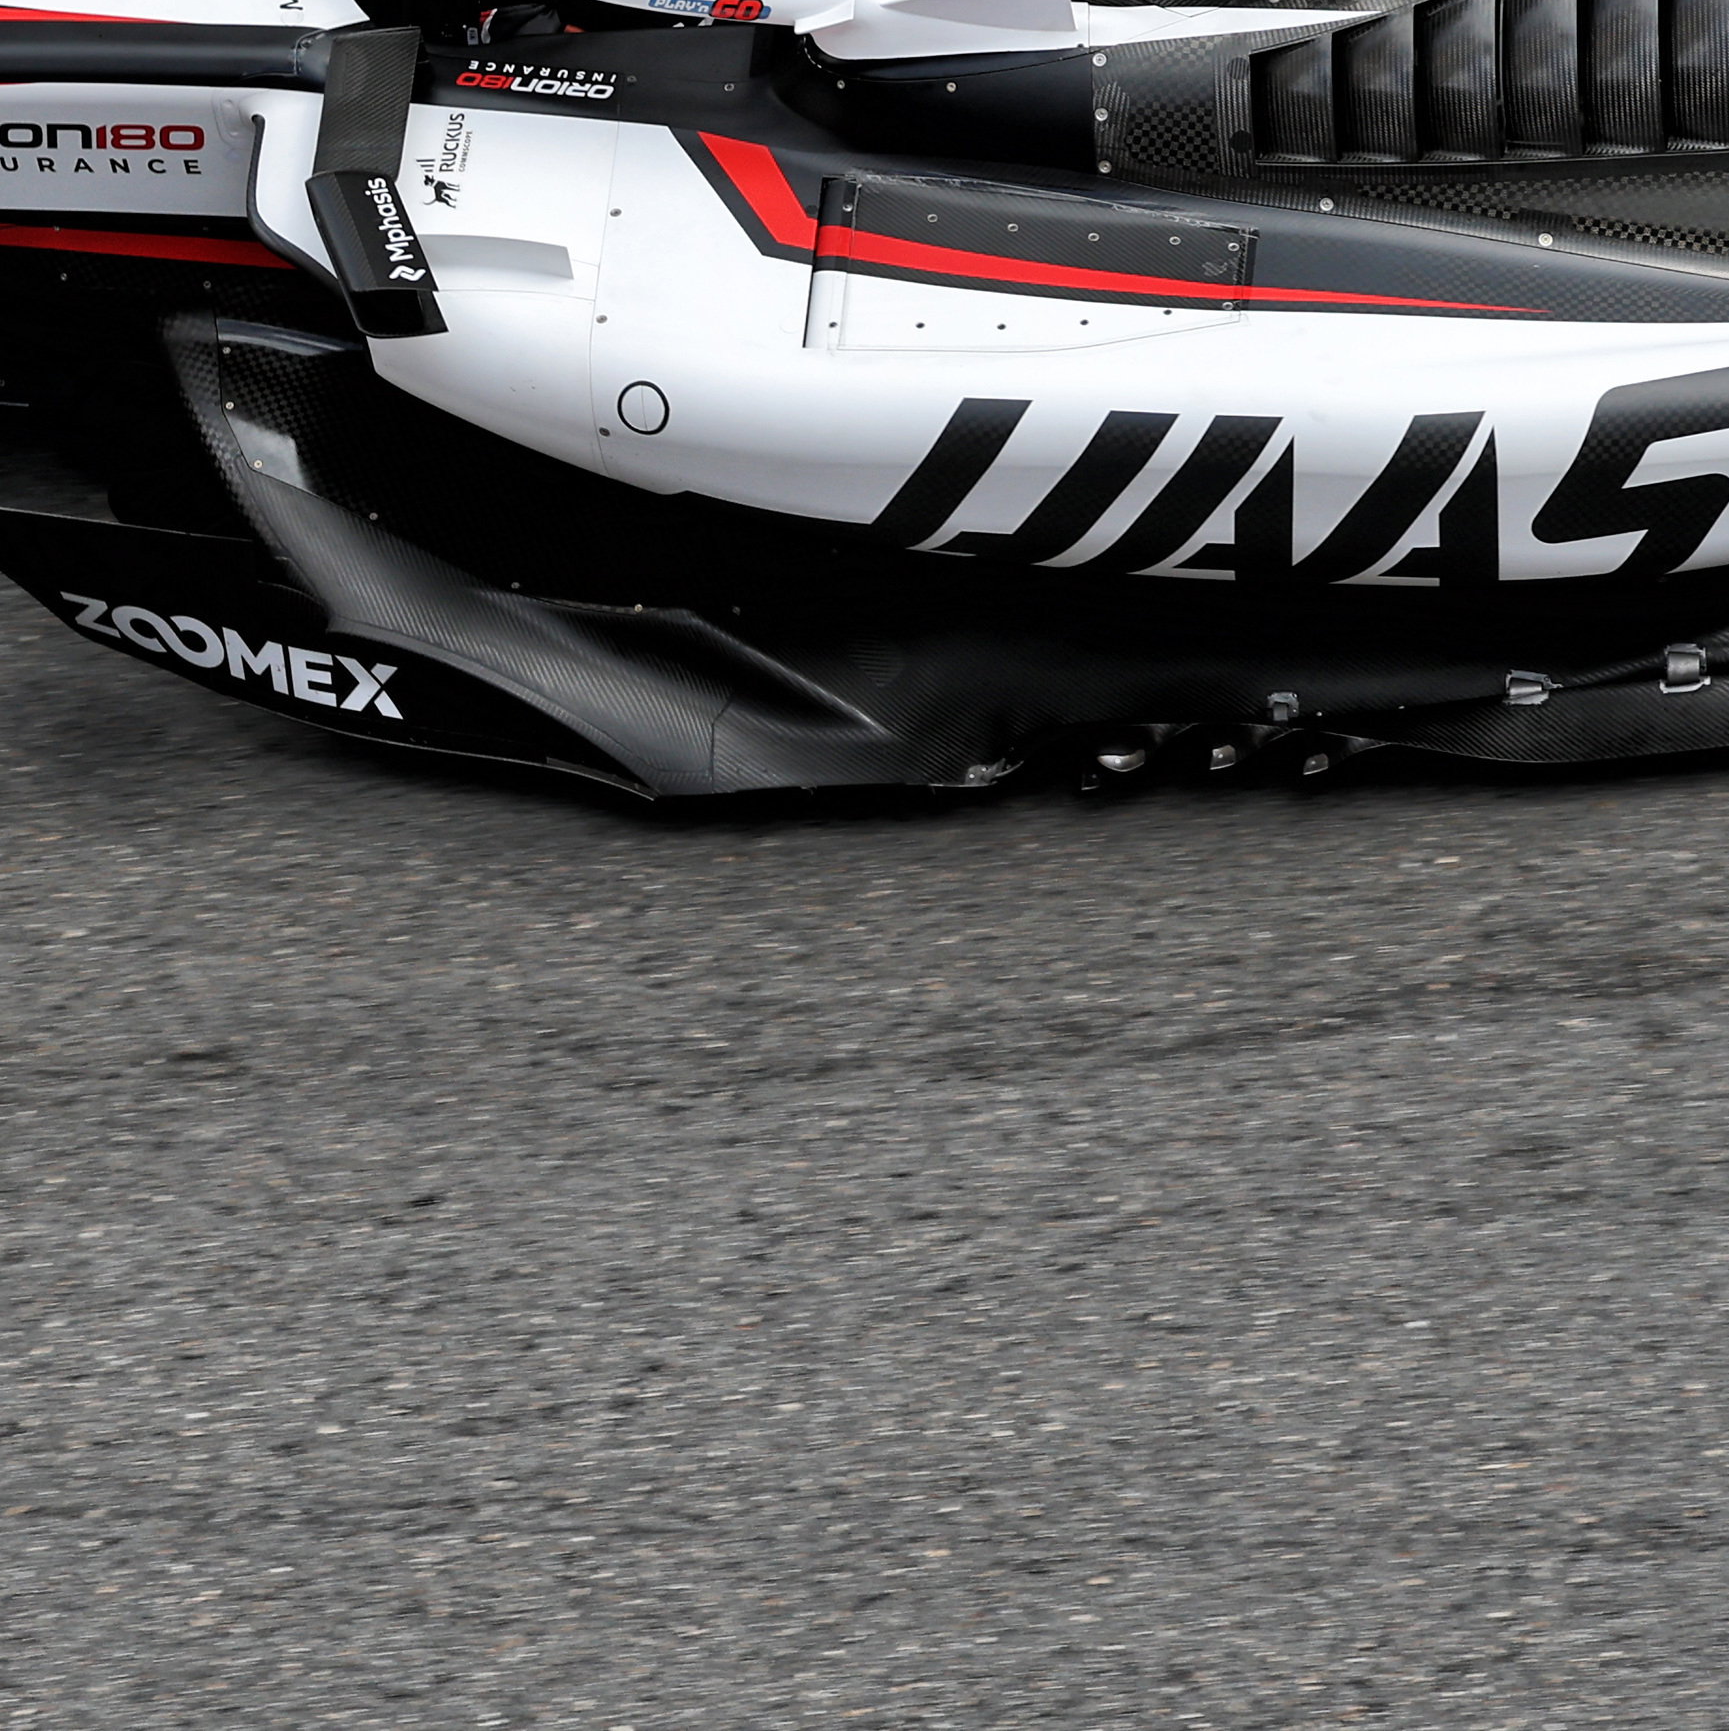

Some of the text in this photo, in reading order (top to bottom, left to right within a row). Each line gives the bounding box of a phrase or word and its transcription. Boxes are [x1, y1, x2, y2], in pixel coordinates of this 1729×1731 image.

[455, 71, 615, 100] ORION180
[468, 59, 617, 83] INSURANCE
[439, 112, 465, 173] RUCKUS
[459, 130, 474, 173] COMMSCOPE
[363, 176, 415, 263] Mphasis
[59, 591, 404, 720] ZOOMEX
